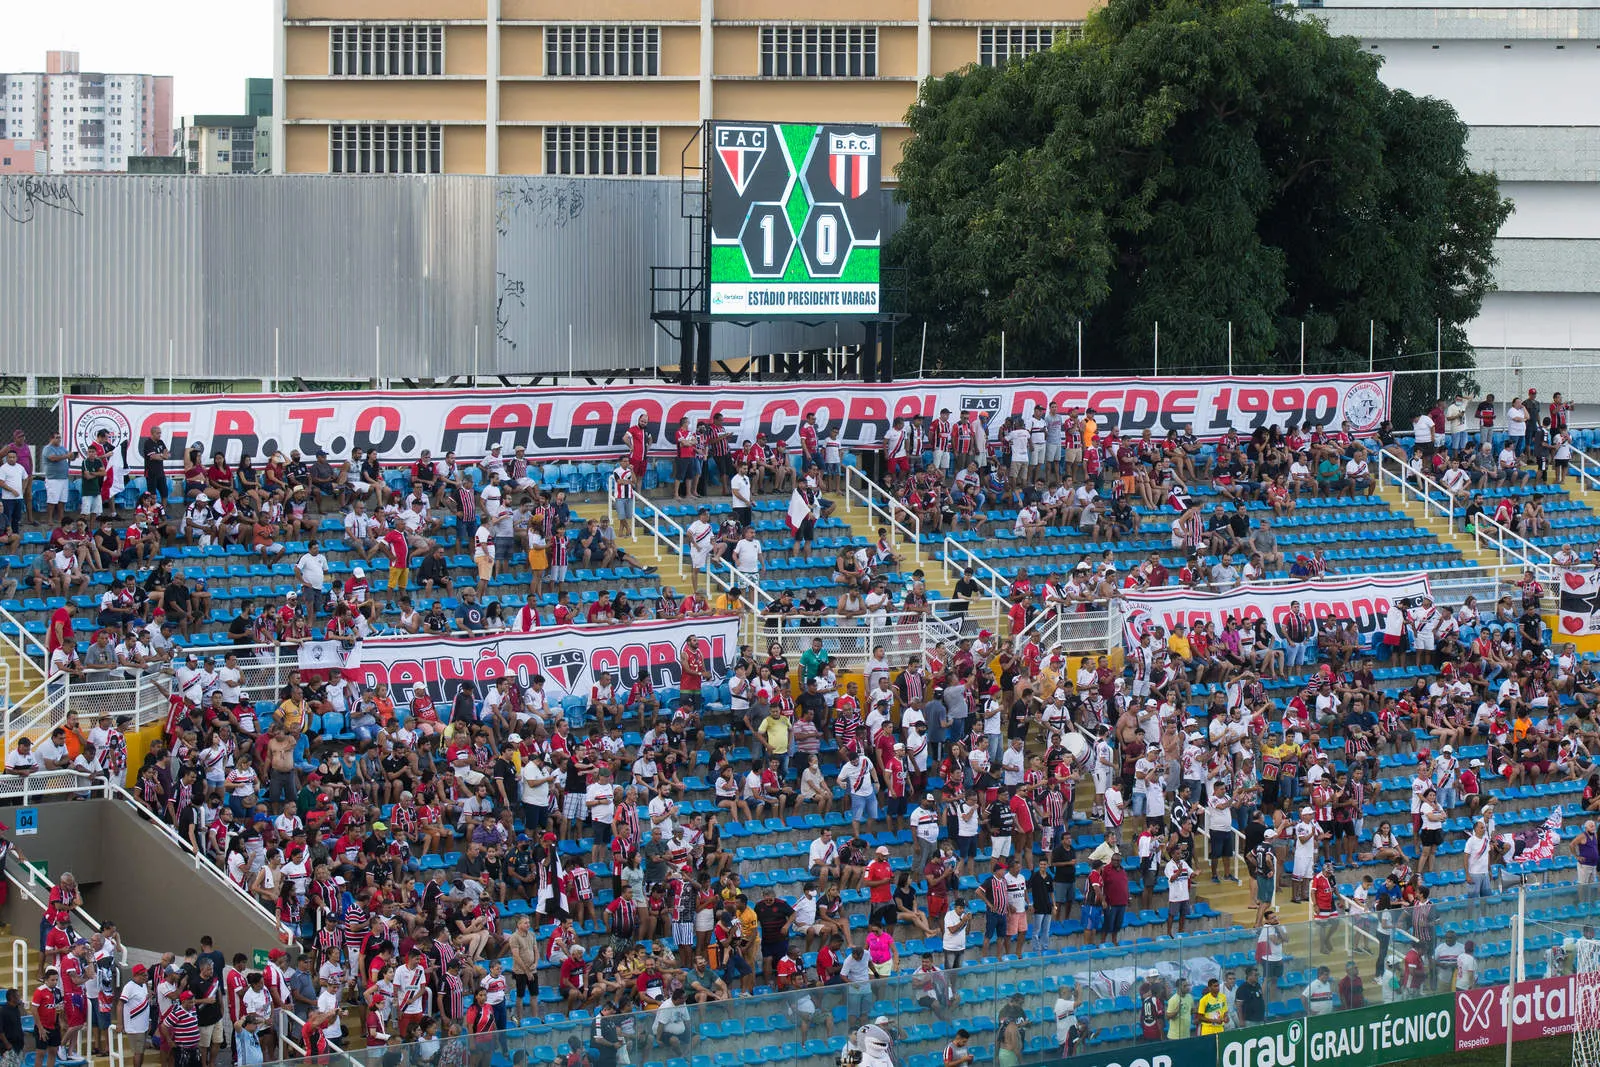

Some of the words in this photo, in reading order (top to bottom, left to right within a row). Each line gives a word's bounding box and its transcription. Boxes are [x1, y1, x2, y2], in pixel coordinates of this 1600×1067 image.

[760, 215, 774, 266] 1
[817, 215, 837, 265] 0
[748, 289, 785, 306] ESTÁDIO
[788, 291, 840, 306] PRESIDENTE
[842, 292, 876, 306] VARGAS
[1207, 386, 1339, 429] 1990
[20, 816, 33, 827] 04
[1310, 1025, 1364, 1062] GRAU
[1369, 1010, 1451, 1050] TÉCNICO
[1458, 1036, 1490, 1049] Respeito
